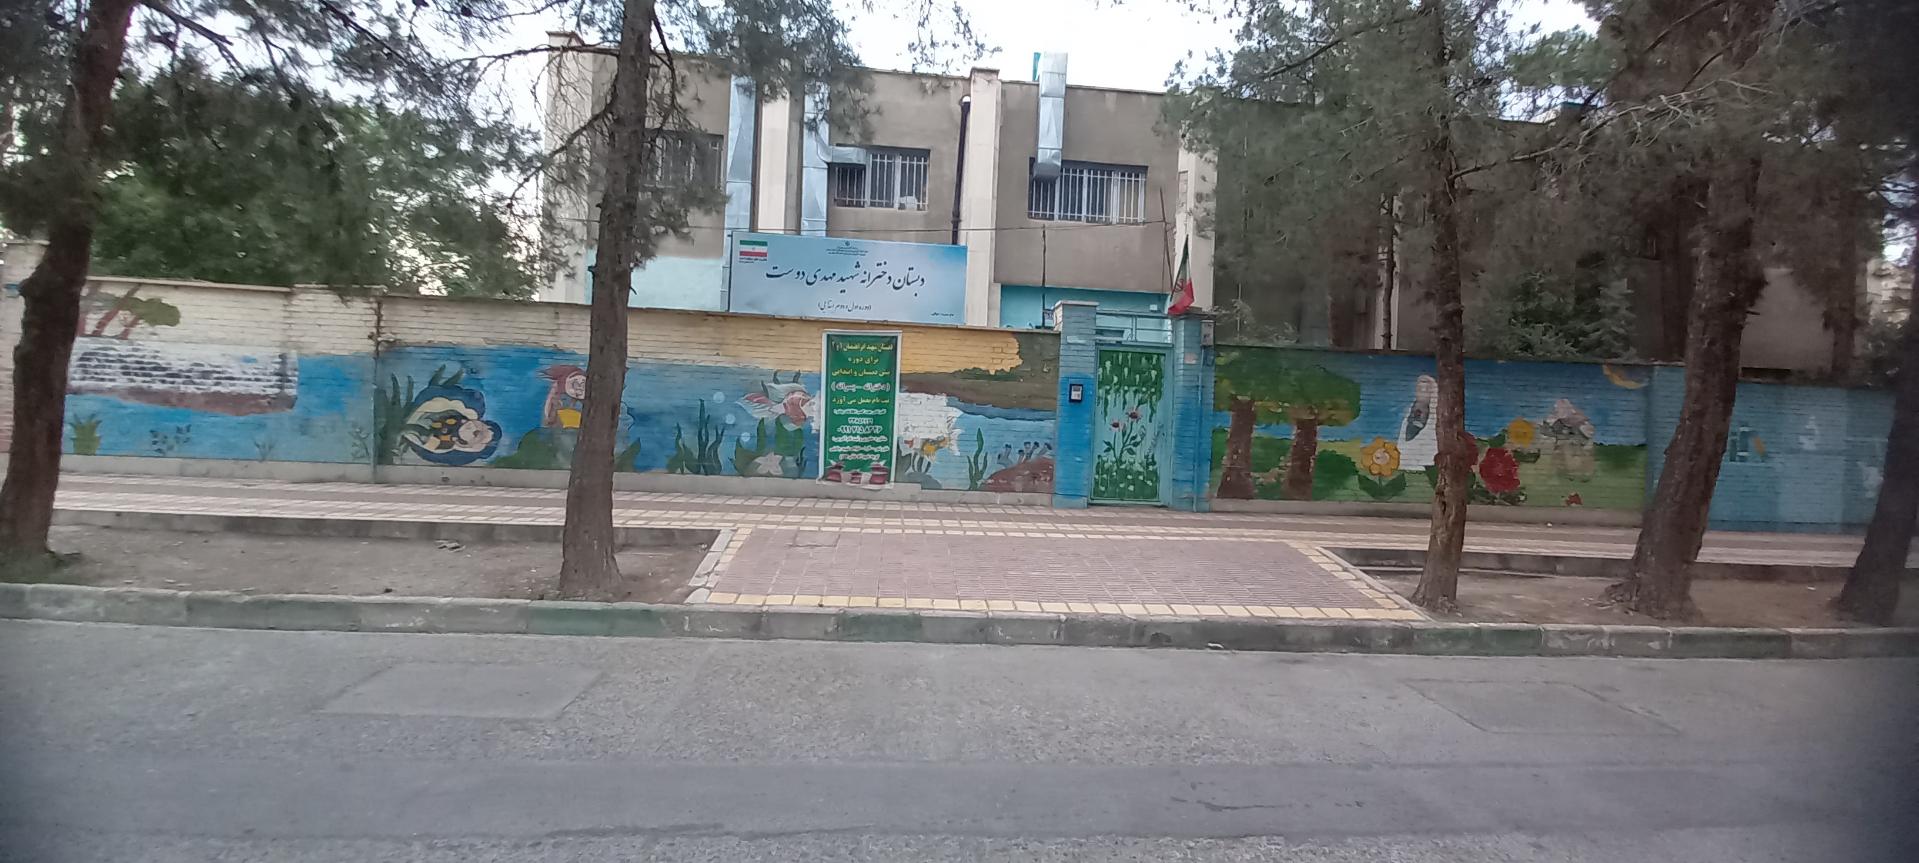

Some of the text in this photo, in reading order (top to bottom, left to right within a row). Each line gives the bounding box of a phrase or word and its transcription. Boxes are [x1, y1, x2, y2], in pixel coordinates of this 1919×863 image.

[806, 268, 837, 286] مهدی
[839, 261, 861, 293] شهید
[860, 261, 892, 289] دخترانه
[892, 266, 926, 297] دبستان
[864, 356, 879, 365] برای
